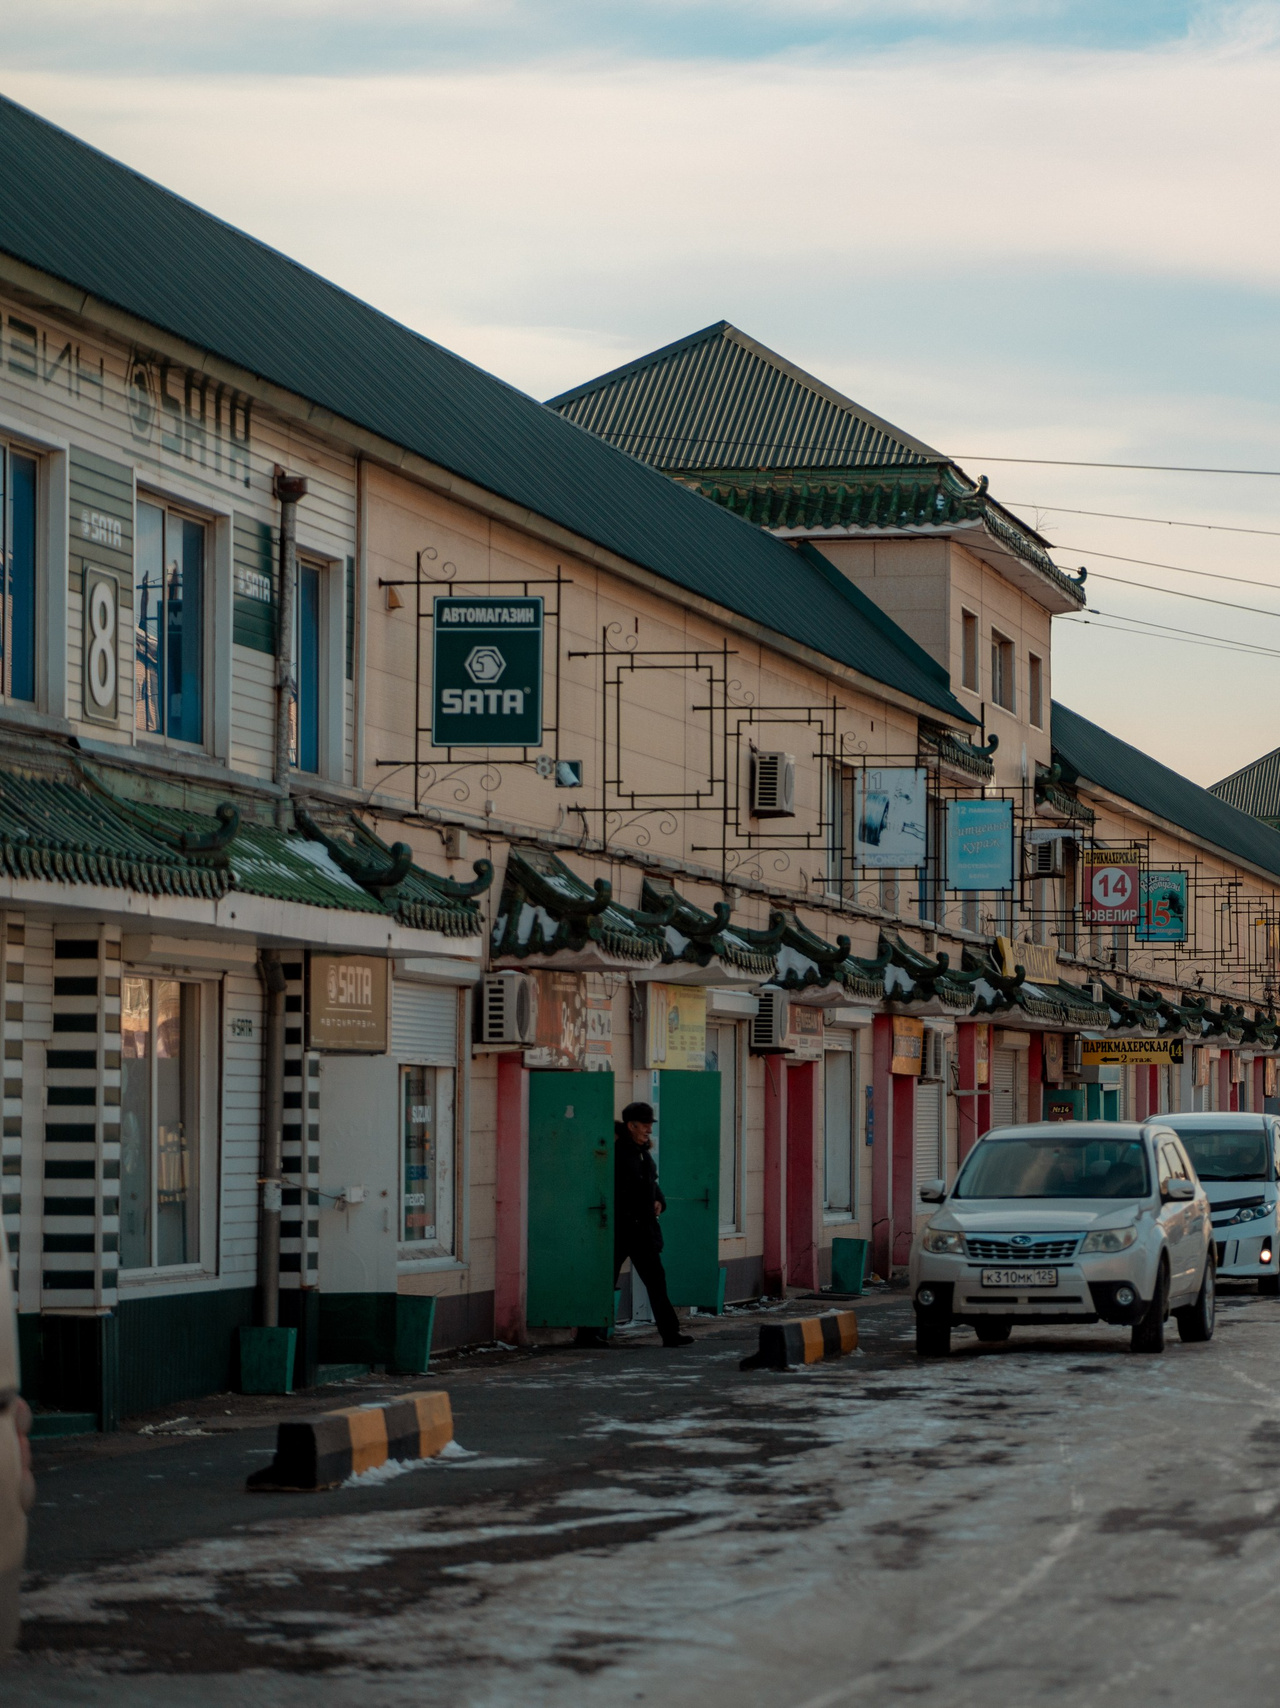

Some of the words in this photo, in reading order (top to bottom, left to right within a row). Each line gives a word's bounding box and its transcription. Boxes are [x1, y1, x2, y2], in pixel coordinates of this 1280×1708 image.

[1, 312, 104, 411] ЗИН
[91, 512, 122, 548] SATA
[246, 570, 271, 603] SATA
[441, 607, 534, 623] АВТОМАГАЗИН
[90, 581, 115, 707] 8
[441, 688, 524, 715] SATA
[861, 771, 882, 790] 11
[1099, 874, 1127, 898] 14
[1086, 909, 1137, 922] ЮВЕЛИР
[1140, 899, 1171, 927] 15
[339, 965, 372, 1005] SATA
[236, 1018, 252, 1037] SATA
[1082, 1041, 1169, 1053] ПАРИКМАХЕРСКАЯ
[1170, 1044, 1183, 1057] 14
[1121, 1054, 1128, 1063] 2
[987, 1271, 1033, 1283] К310МК
[1036, 1271, 1054, 1280] 125
